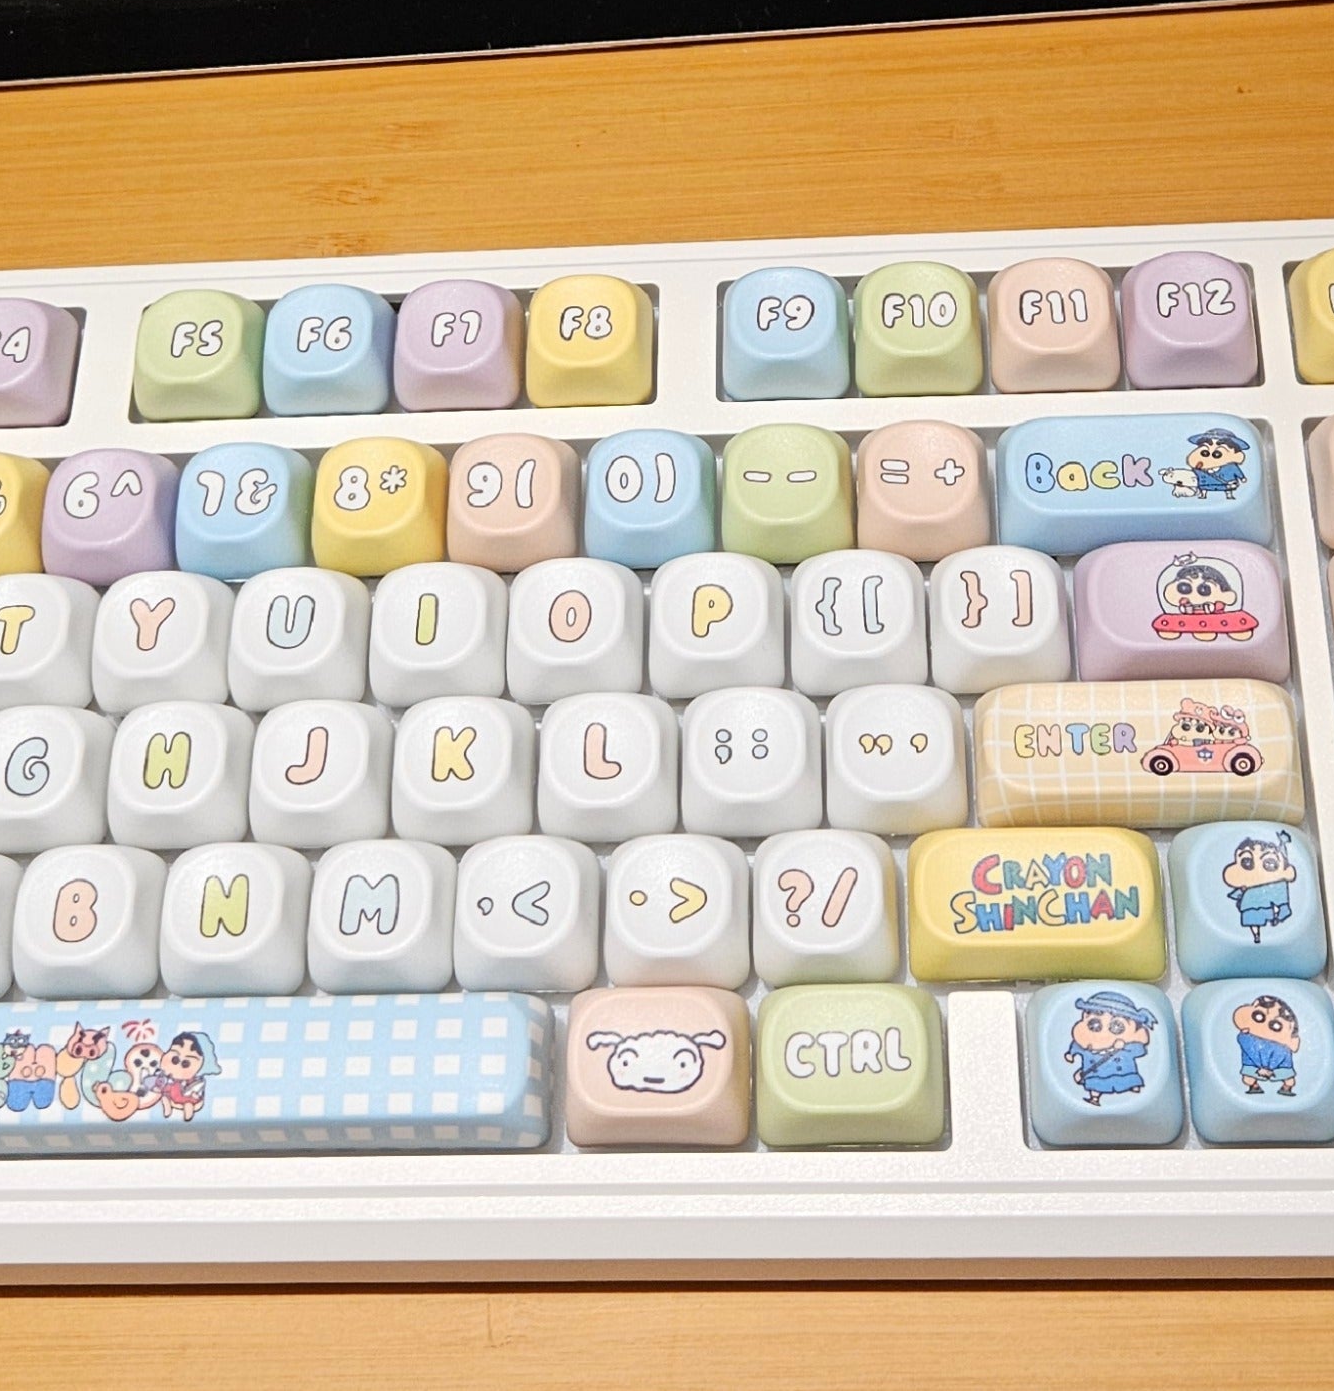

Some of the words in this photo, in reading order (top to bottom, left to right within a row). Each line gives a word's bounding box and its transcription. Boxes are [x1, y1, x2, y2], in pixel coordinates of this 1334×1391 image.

[559, 305, 613, 341] F8
[756, 295, 815, 331] F9
[880, 291, 958, 329] F10
[1019, 288, 1089, 326] F11
[1156, 278, 1237, 318] F12
[170, 319, 224, 358] F5
[296, 316, 353, 353] F6
[431, 309, 483, 347] F7
[129, 597, 176, 651] Y
[266, 594, 316, 649] U
[415, 592, 439, 646] I
[548, 589, 592, 643] O
[691, 584, 733, 638] P
[5, 736, 51, 796] G
[142, 731, 192, 789] H
[285, 726, 329, 785] J
[431, 725, 477, 782] K
[582, 722, 622, 780] L
[1013, 721, 1138, 759] ENTER
[971, 852, 1113, 896] CRAYON
[52, 877, 99, 943] B
[199, 873, 250, 938] N
[338, 873, 400, 936] M
[950, 886, 1140, 934] SHINCHAN
[783, 1027, 913, 1079] CTRL
